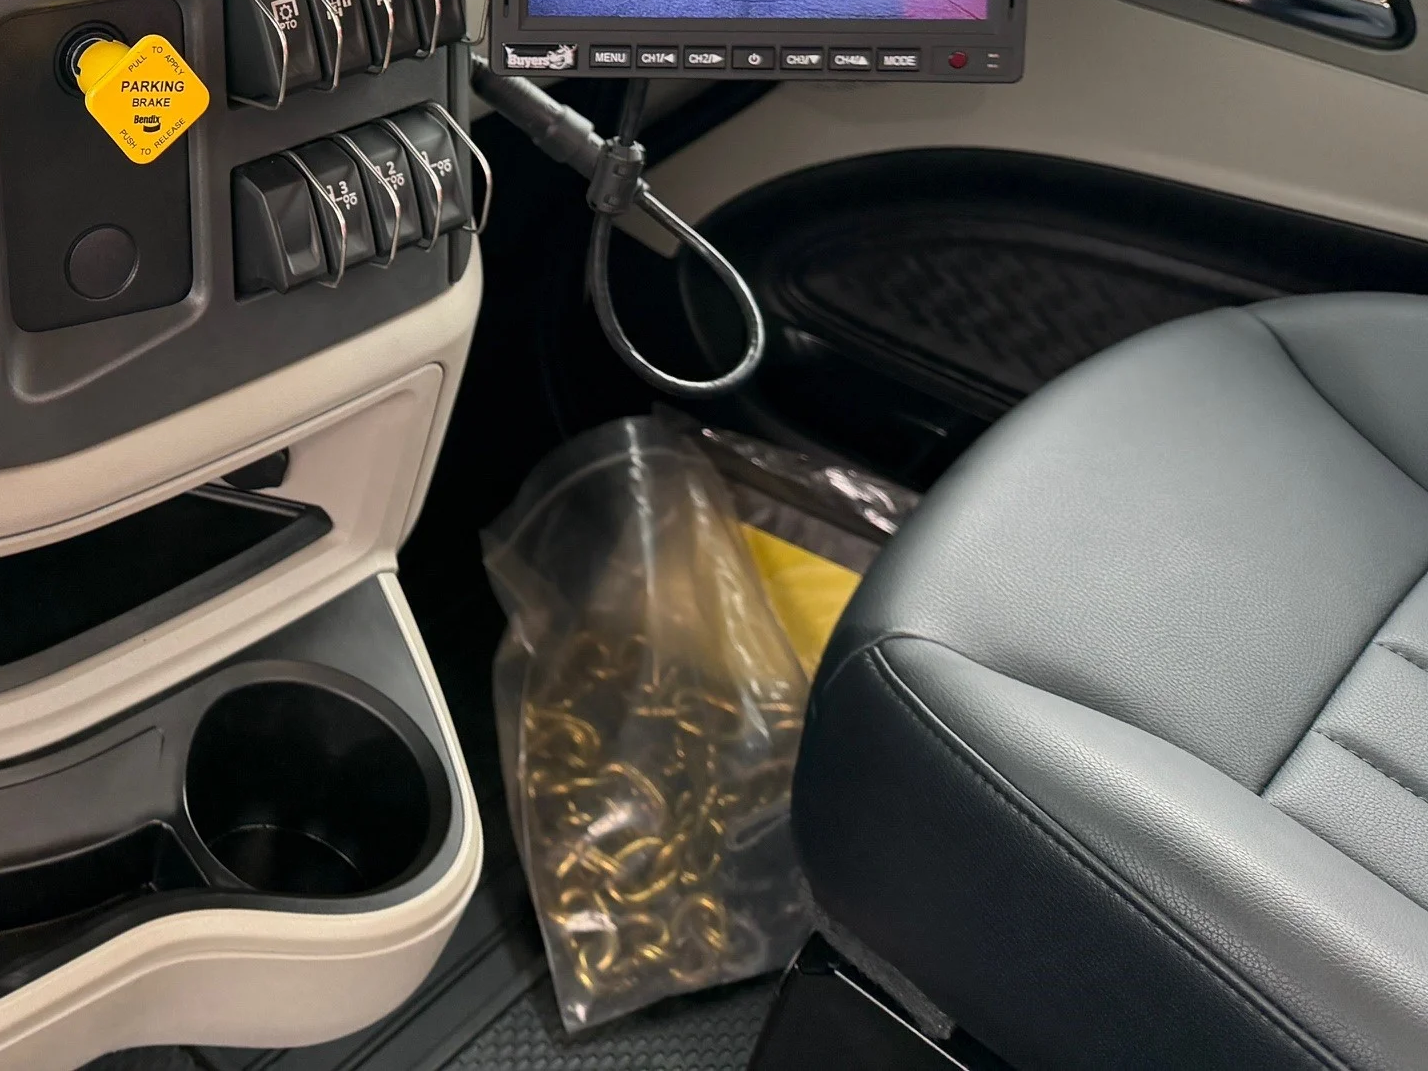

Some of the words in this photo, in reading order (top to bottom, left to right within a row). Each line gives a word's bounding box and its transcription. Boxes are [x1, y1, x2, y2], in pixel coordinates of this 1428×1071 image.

[278, 19, 297, 30] PTO
[128, 54, 147, 73] PULL
[152, 46, 163, 54] TO
[164, 54, 185, 76] APPLY
[507, 53, 550, 67] Buyers
[595, 52, 626, 63] MENU
[883, 55, 917, 66] MODE
[121, 80, 185, 93] PARKING
[132, 98, 171, 108] BRAKE
[134, 114, 161, 124] Bendix
[119, 129, 137, 149] PUSH
[140, 148, 152, 156] TO
[154, 117, 186, 149] RELEASE
[386, 161, 396, 175] 2
[338, 181, 348, 194] 3
